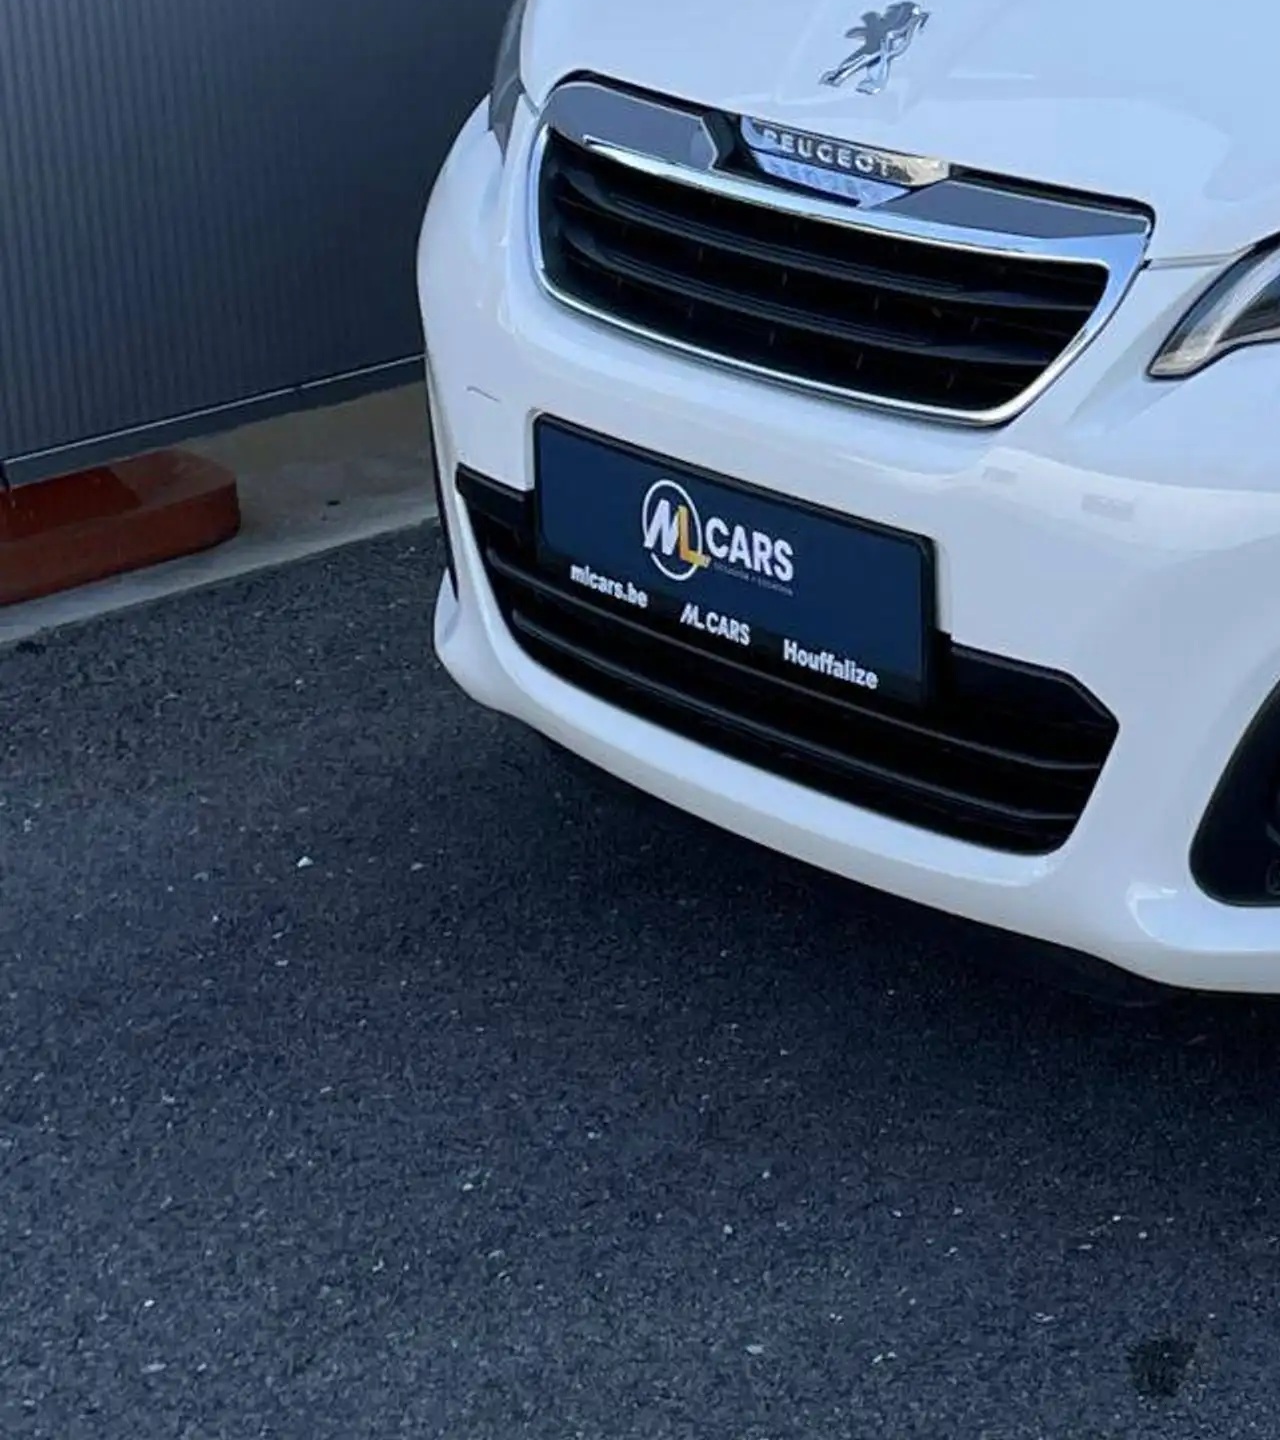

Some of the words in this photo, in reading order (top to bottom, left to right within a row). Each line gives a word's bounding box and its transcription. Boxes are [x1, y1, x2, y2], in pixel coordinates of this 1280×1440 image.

[763, 127, 890, 178] PEUGEOT
[705, 516, 795, 582] CARS
[570, 563, 648, 609] mlcars.be
[706, 611, 750, 646] CARS
[783, 638, 879, 690] Houffalize
